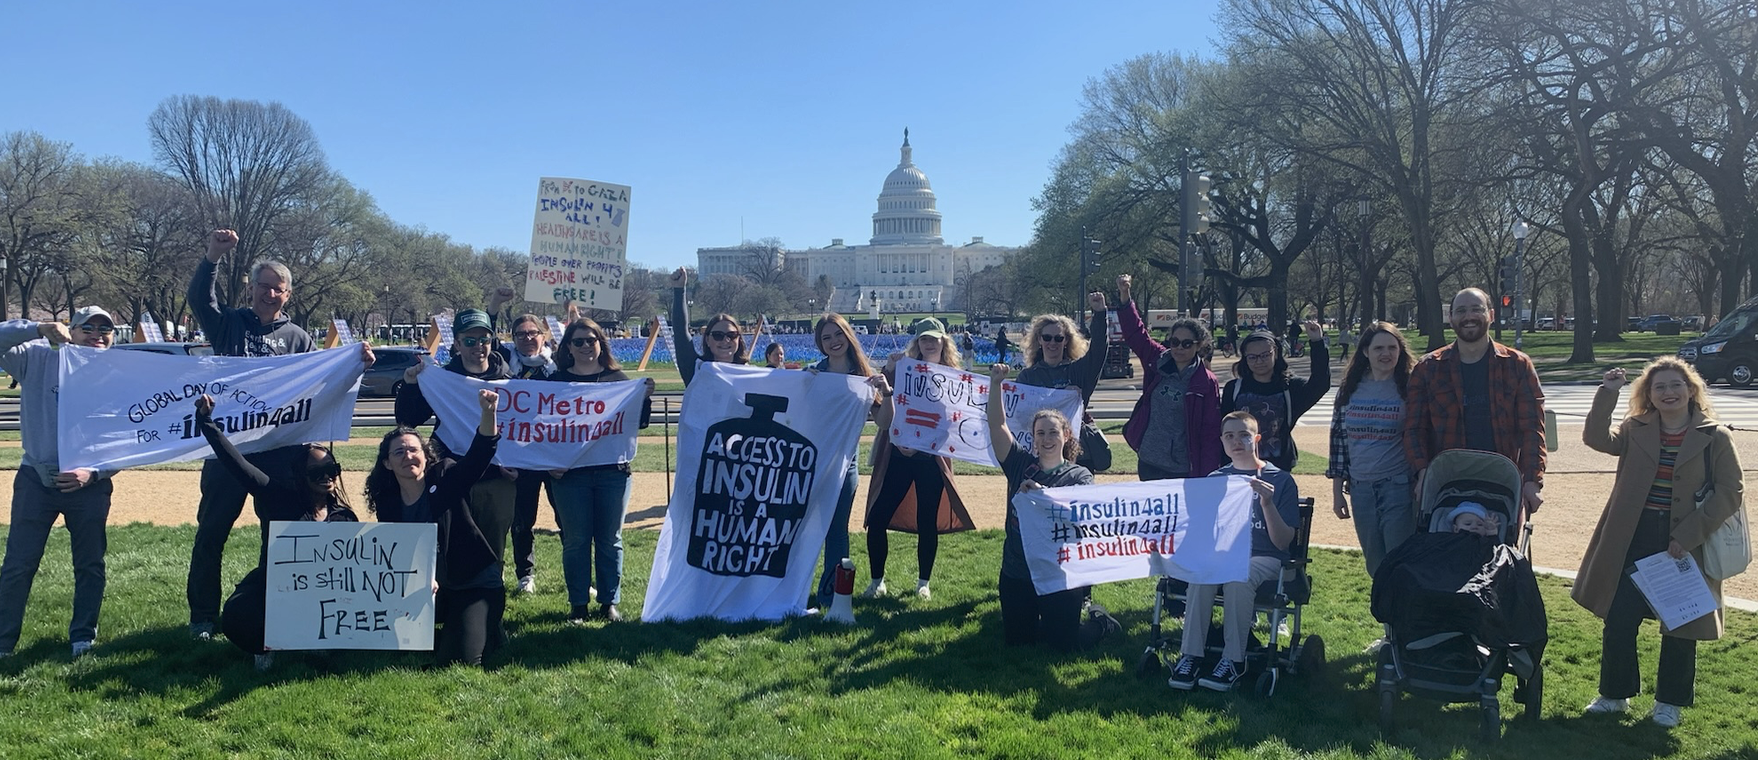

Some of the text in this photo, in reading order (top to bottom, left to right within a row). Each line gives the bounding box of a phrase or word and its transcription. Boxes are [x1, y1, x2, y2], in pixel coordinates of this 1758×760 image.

[575, 186, 585, 195] TO
[588, 185, 628, 202] GAZA
[541, 197, 613, 219] INSULIN 4
[537, 223, 597, 242] HEALTHCARE
[616, 235, 624, 246] A
[532, 253, 622, 278] PEOPLE OVER PROFITS
[529, 270, 621, 290] PALESTINE WILL BE
[128, 382, 272, 424] GLOBAL DAY OF ACTION
[494, 387, 606, 415] DC Metro
[137, 429, 161, 444] FOR
[706, 432, 815, 471] ACCESS TO
[702, 458, 812, 505] INSULIN
[728, 499, 767, 518] IS A
[1045, 493, 1179, 522] #insulin4all
[695, 508, 802, 546] HUMAN
[1051, 515, 1177, 543] #insulin4all
[701, 540, 780, 573] RIGHT
[293, 573, 308, 591] is
[362, 569, 417, 603] NOT
[318, 598, 391, 640] FREE
